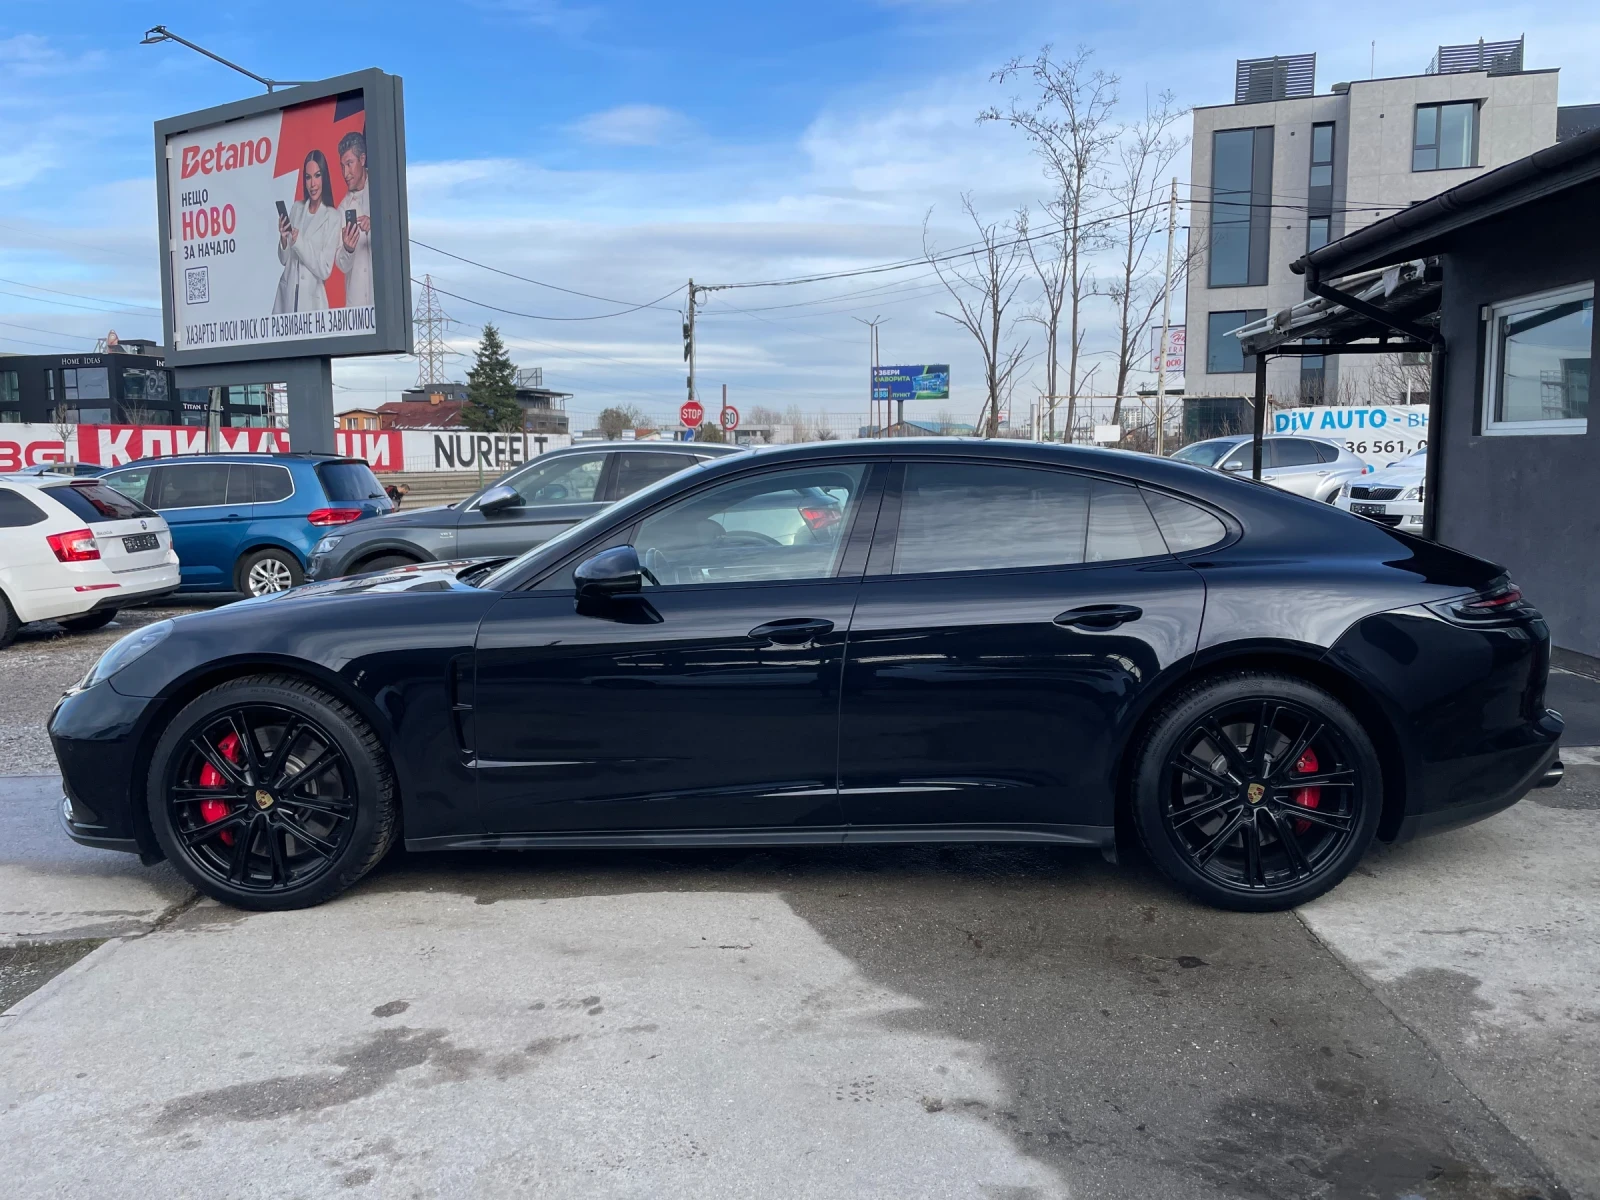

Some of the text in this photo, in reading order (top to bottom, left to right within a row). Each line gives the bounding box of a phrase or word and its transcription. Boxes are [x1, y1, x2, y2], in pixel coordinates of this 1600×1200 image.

[181, 137, 272, 180] Betano
[182, 189, 209, 207] НЕЩО
[182, 204, 236, 241] НОВО
[184, 239, 236, 260] ЗА НАЧАЛО
[186, 322, 217, 345] ХАЗАРТЪТ
[220, 320, 238, 342] НОСИ
[241, 318, 258, 340] РИСК
[260, 317, 269, 337] ОТ
[271, 313, 312, 337] РАЗВИВАНЕ
[315, 312, 326, 333] НА
[682, 409, 702, 420] STOP
[1276, 412, 1315, 433] DiV
[1320, 409, 1387, 430] AUTO
